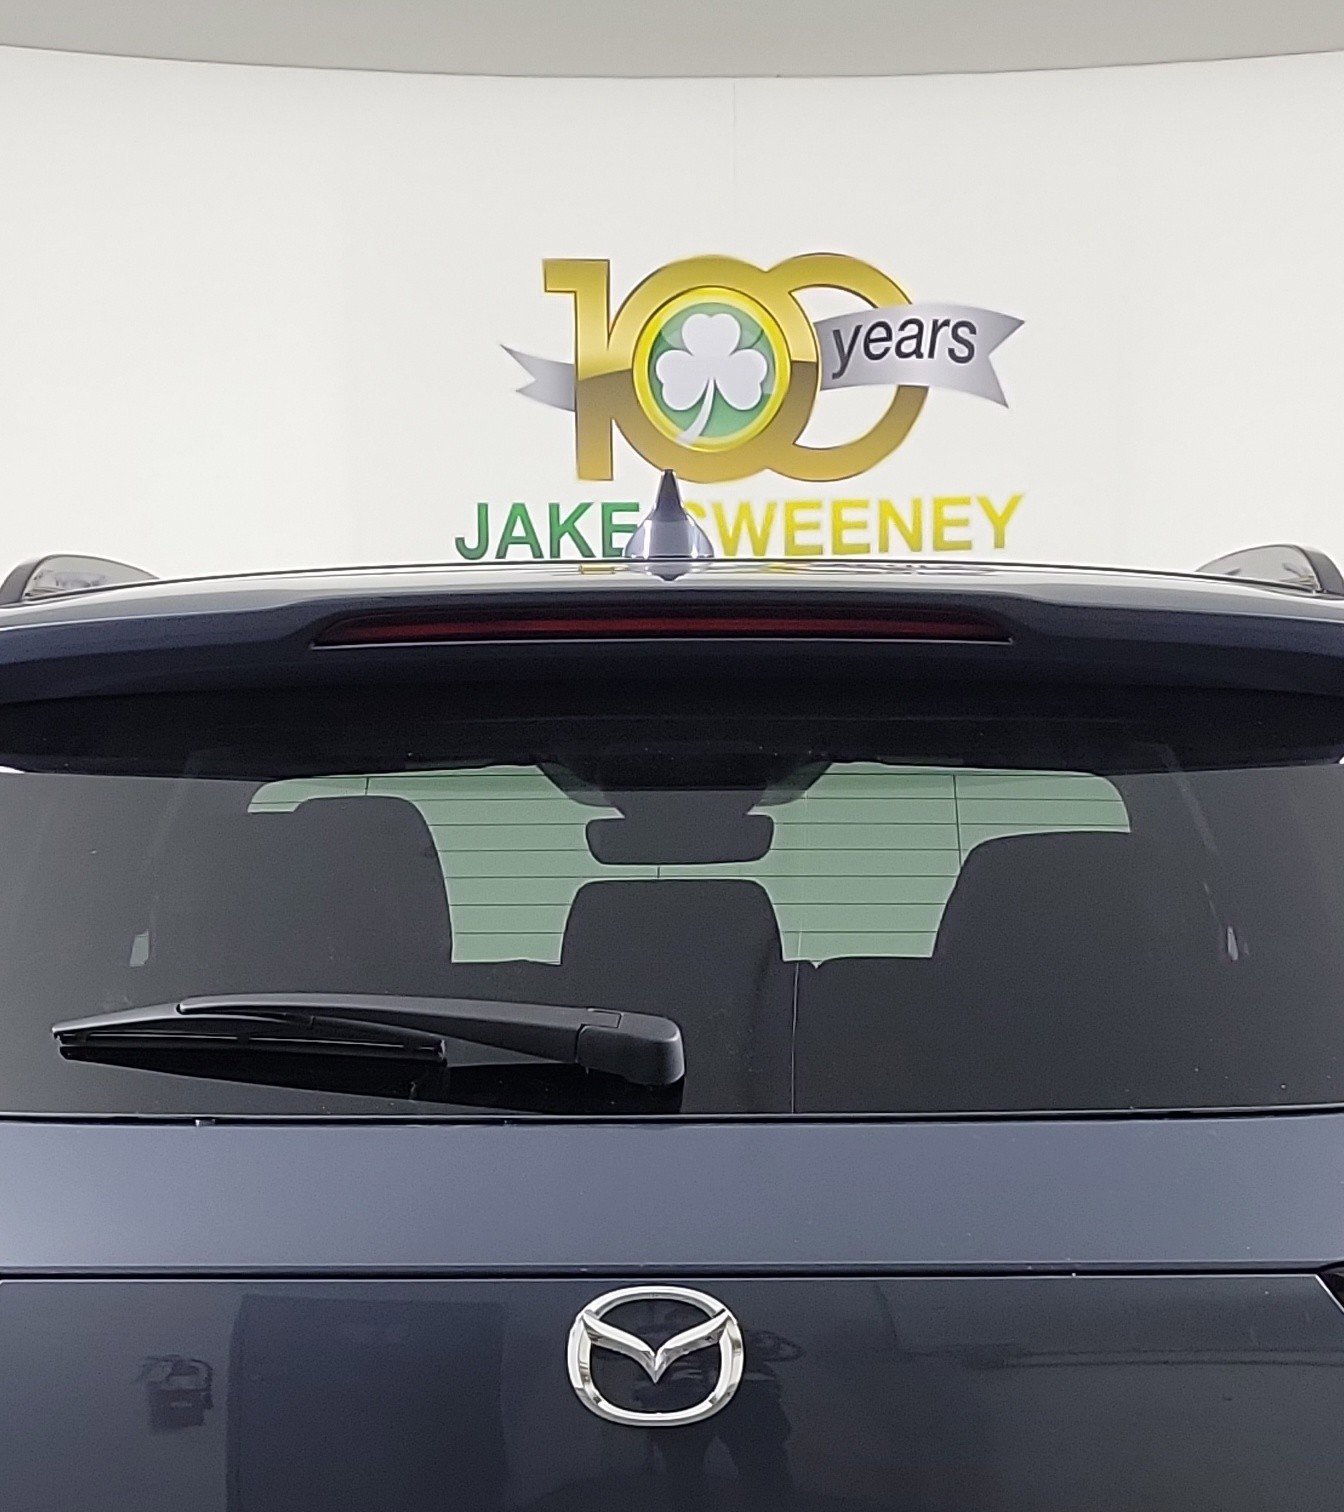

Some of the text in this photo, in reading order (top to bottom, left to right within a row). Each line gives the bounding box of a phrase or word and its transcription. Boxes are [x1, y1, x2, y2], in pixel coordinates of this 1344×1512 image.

[543, 252, 977, 483] 100 years
[456, 501, 640, 561] JAKE
